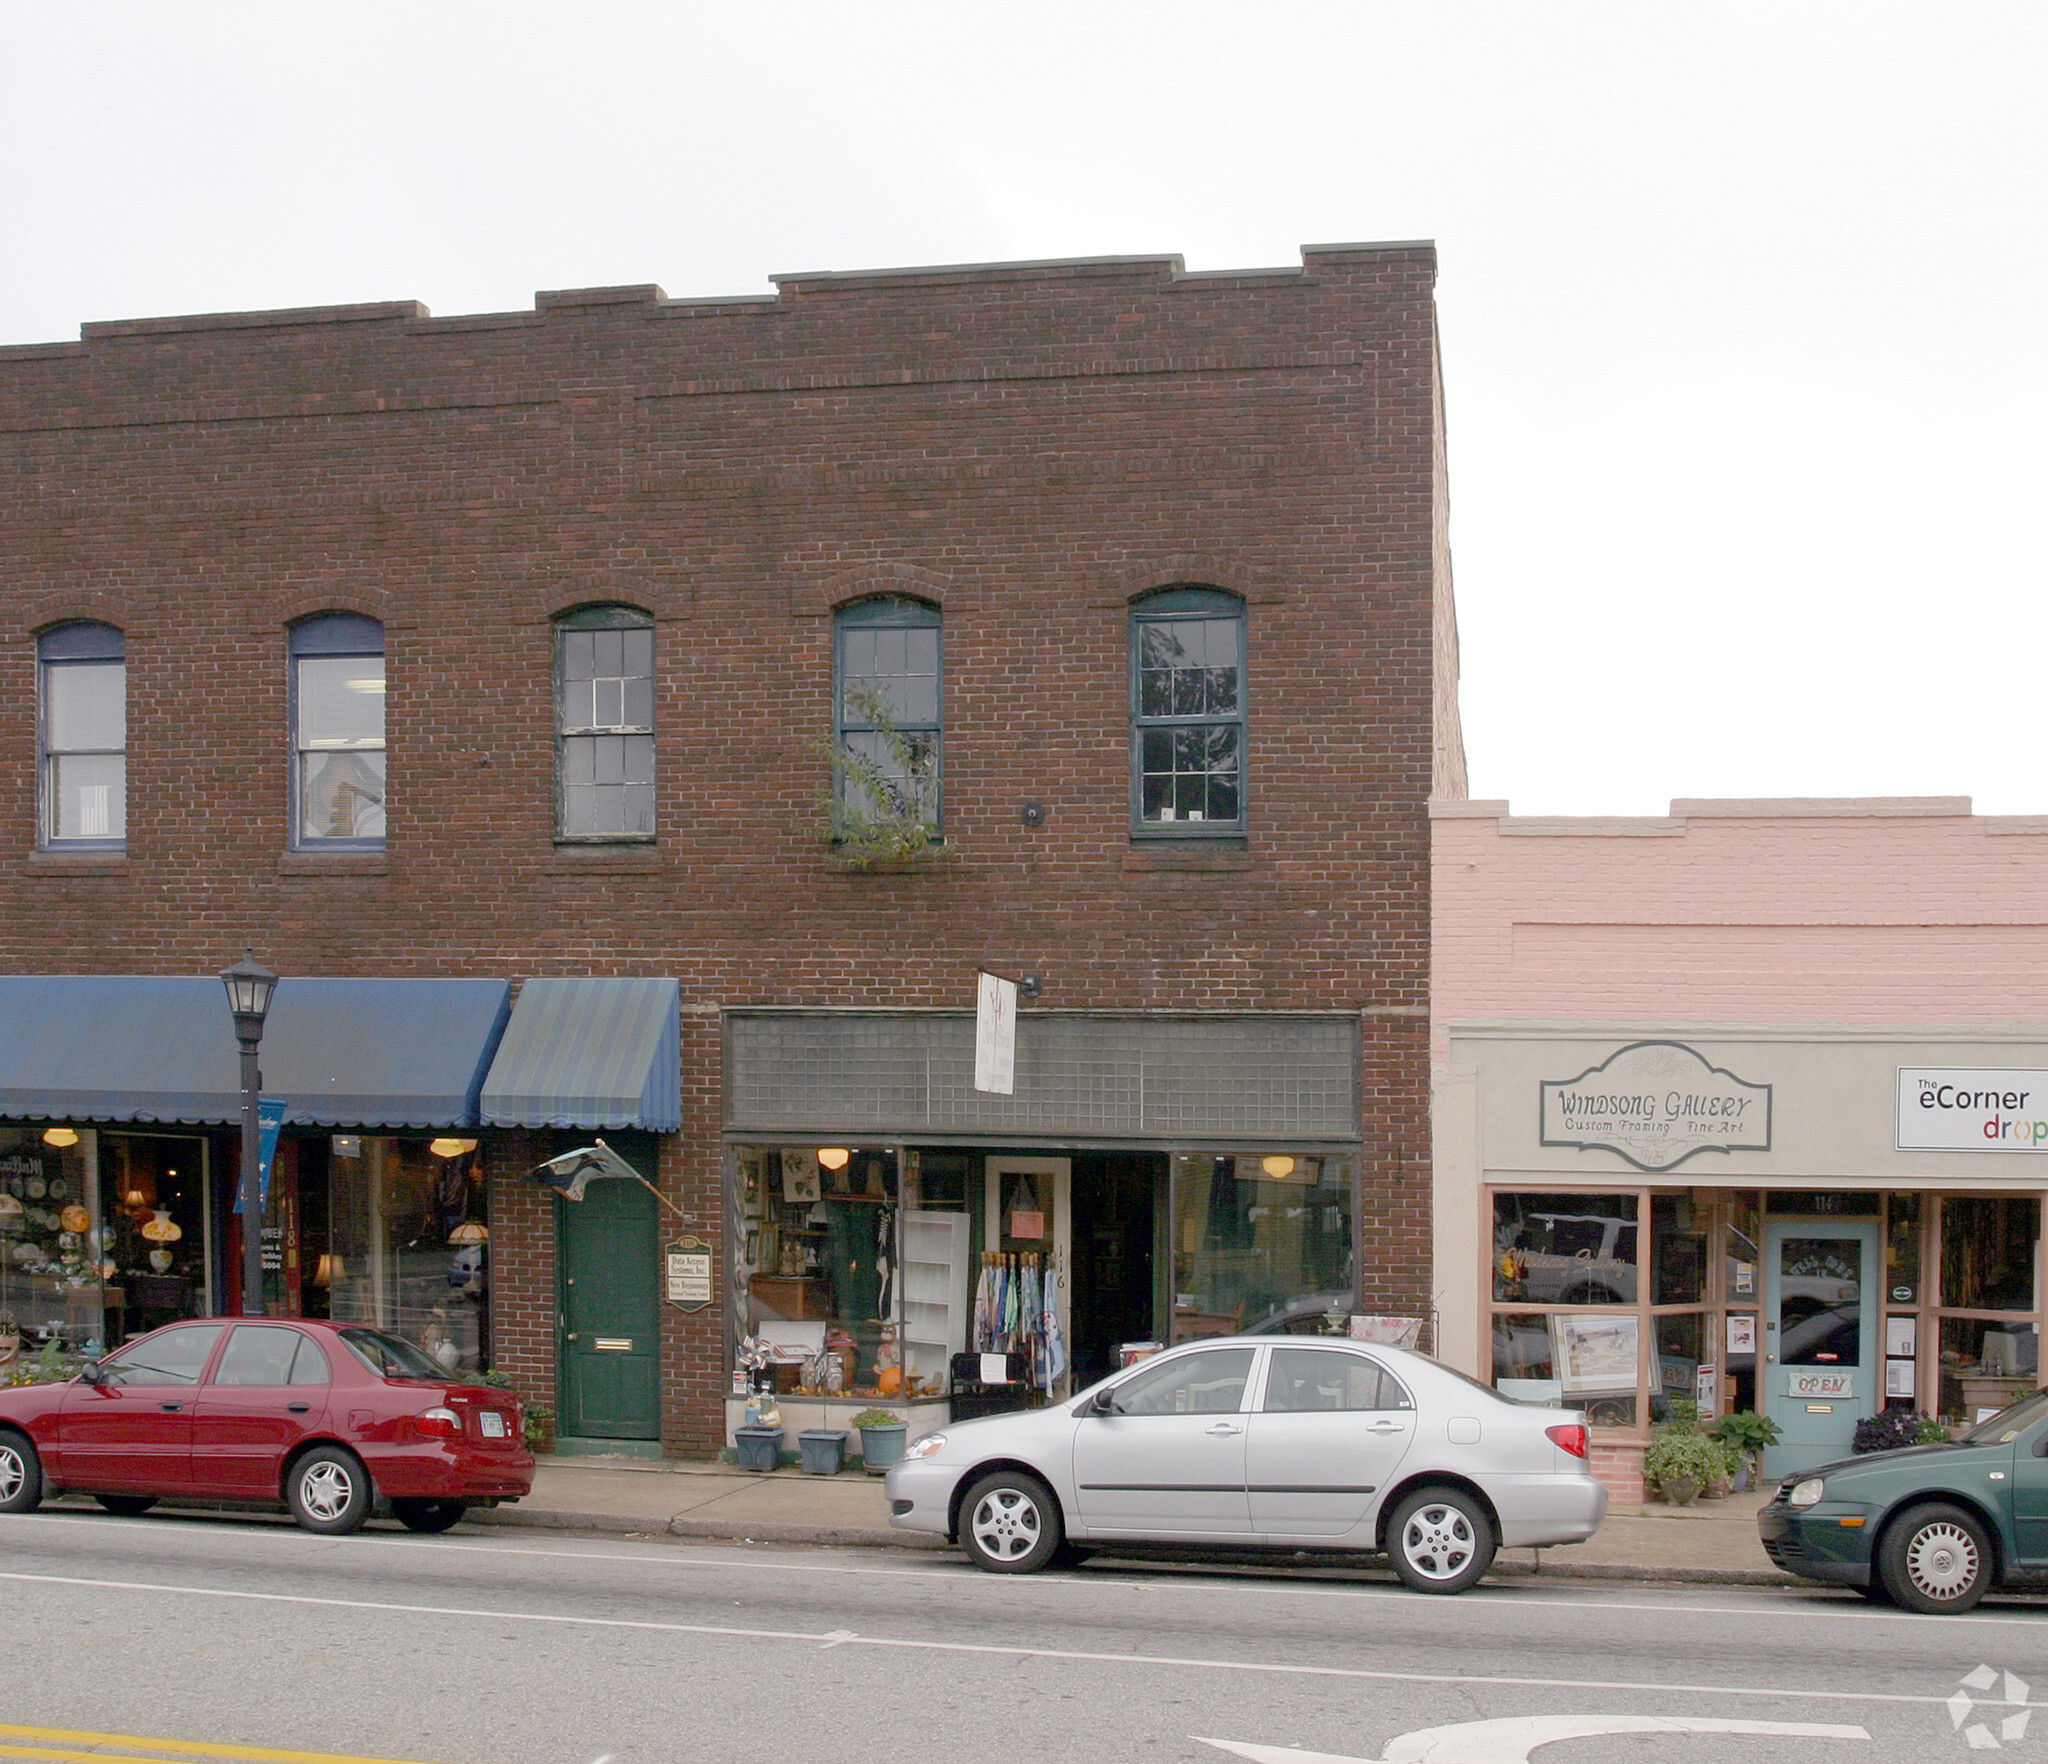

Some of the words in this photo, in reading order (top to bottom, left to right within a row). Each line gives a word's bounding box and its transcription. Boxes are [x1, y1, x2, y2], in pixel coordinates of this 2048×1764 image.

[1918, 1079, 1937, 1088] The
[1920, 1085, 2030, 1109] eCorner
[1565, 1118, 1612, 1131] Custom
[1619, 1119, 1670, 1136] Framing
[1687, 1121, 1713, 1133] Fine
[1717, 1121, 1744, 1133] Art
[1056, 1244, 1065, 1289] 116
[1798, 1378, 1848, 1392] OPEN
